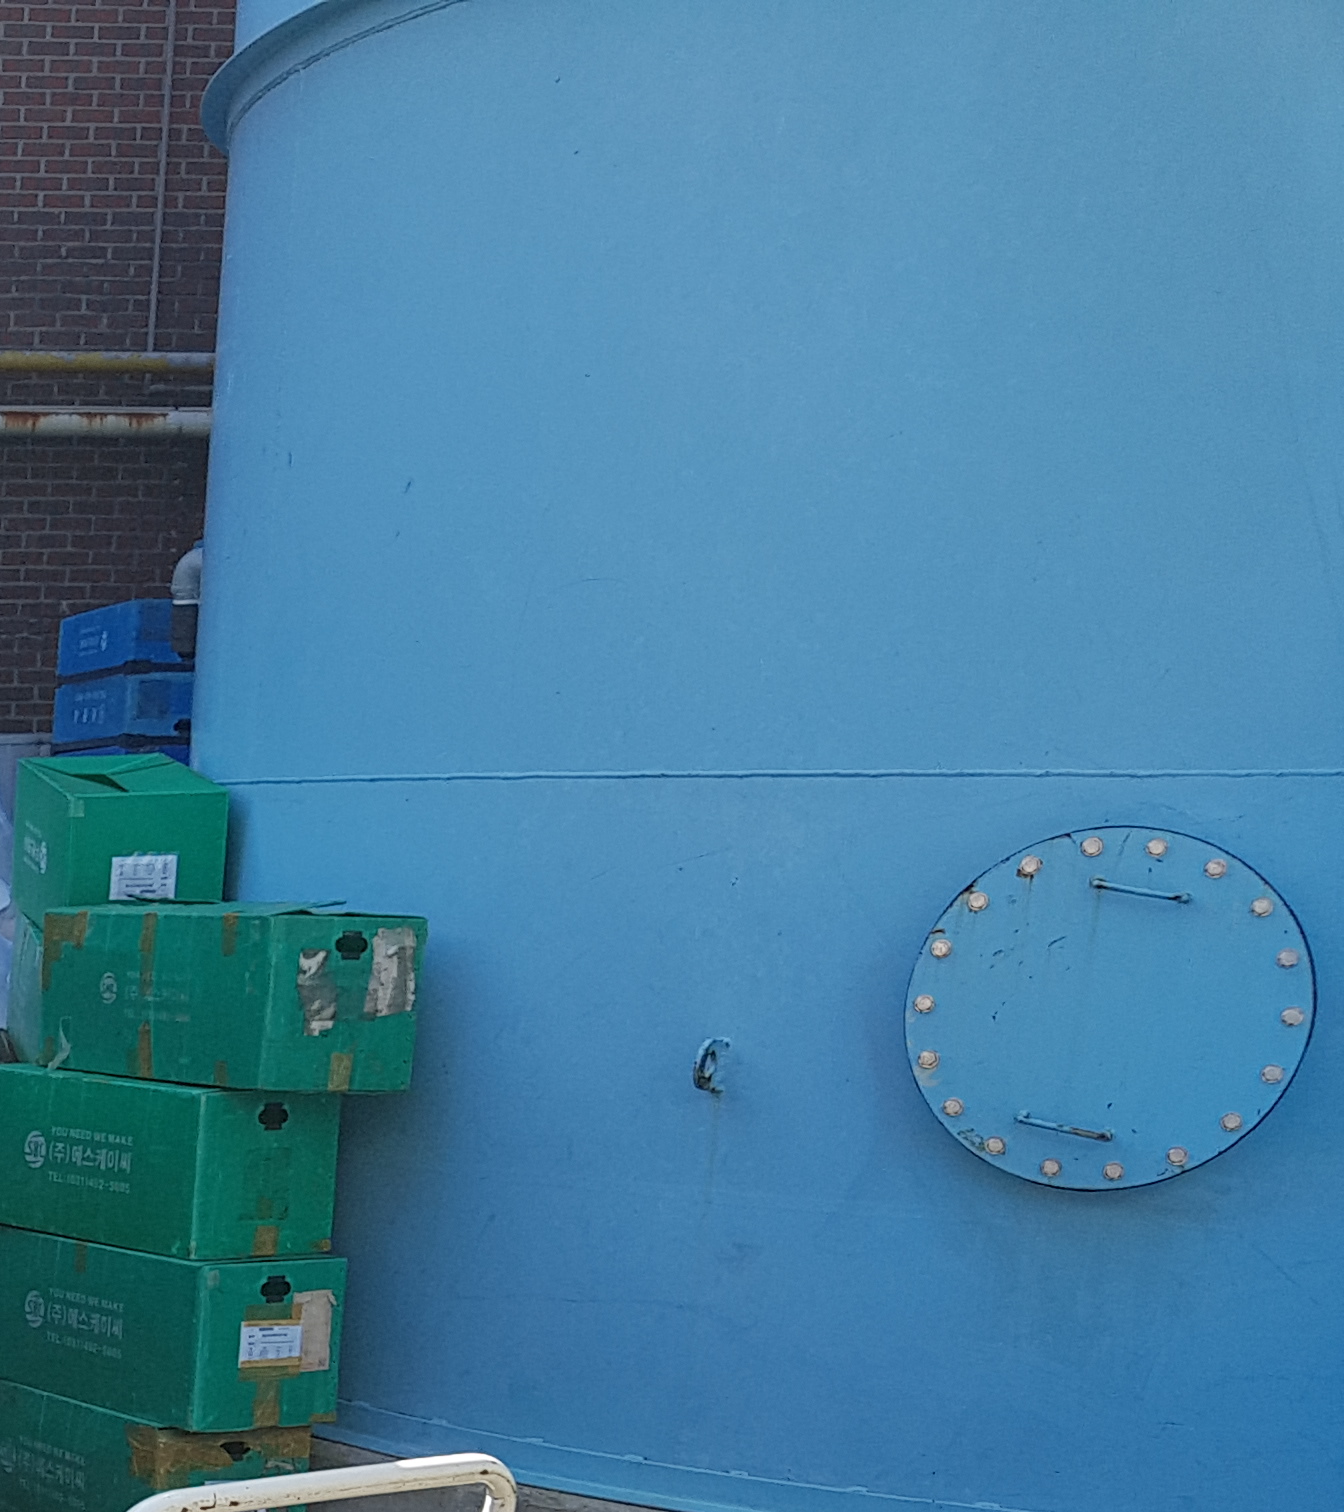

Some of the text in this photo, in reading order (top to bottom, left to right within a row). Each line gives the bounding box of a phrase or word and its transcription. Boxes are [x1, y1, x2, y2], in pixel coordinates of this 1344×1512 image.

[51, 1126, 68, 1138] YOU
[69, 1128, 92, 1141] NEED
[108, 1133, 133, 1147] MAKE
